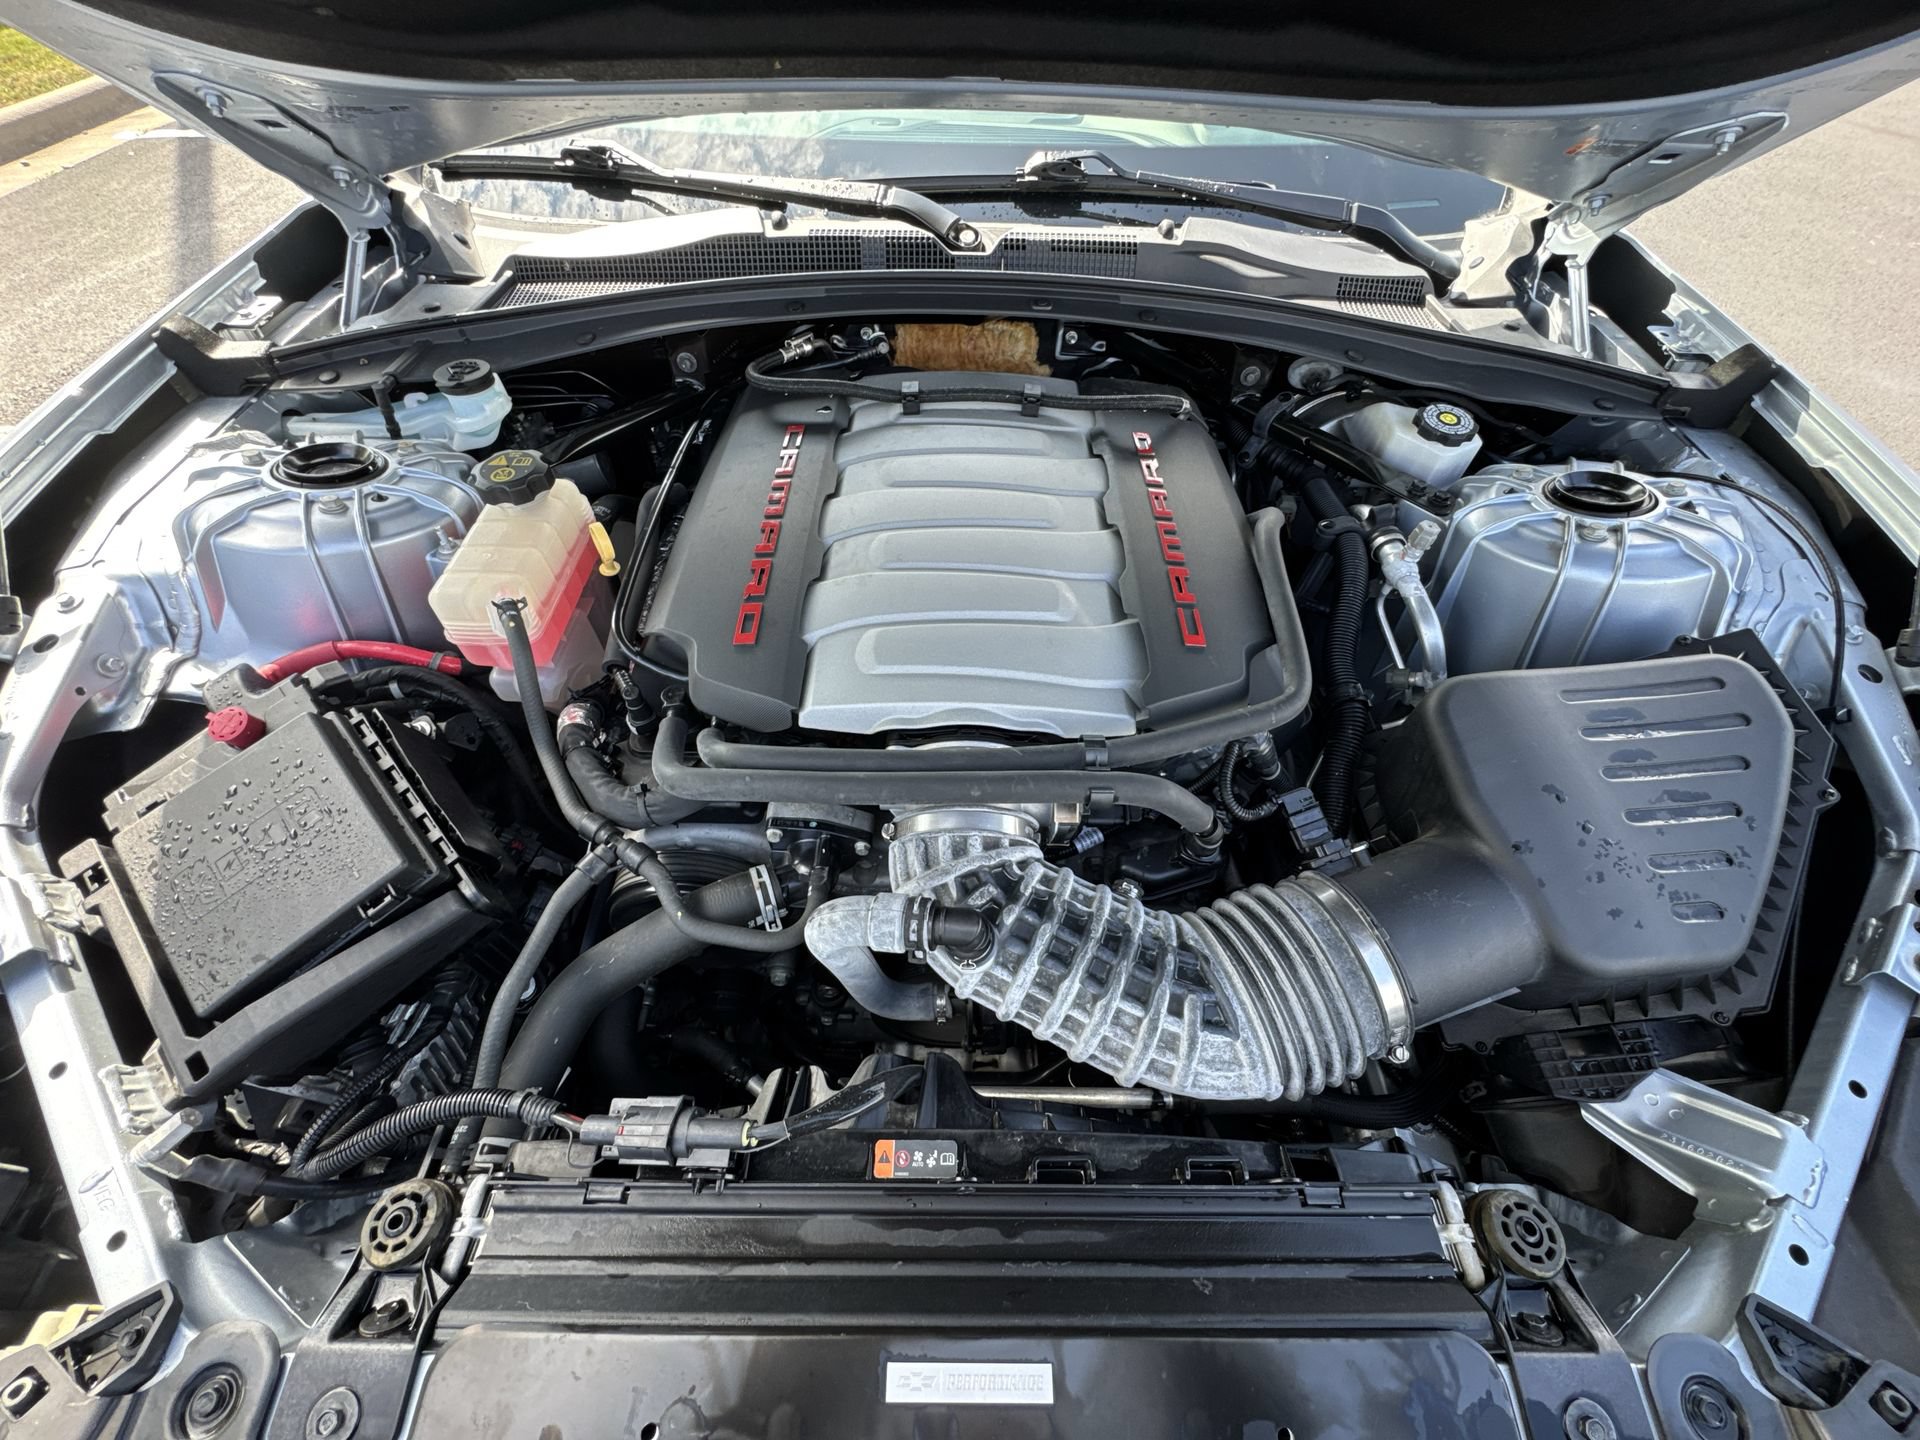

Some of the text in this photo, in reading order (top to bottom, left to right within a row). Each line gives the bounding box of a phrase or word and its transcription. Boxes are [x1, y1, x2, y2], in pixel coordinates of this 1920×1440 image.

[733, 423, 805, 646] CAMARO
[1132, 431, 1207, 647] CAMARO
[945, 1373, 1044, 1391] PERFORMANCE
